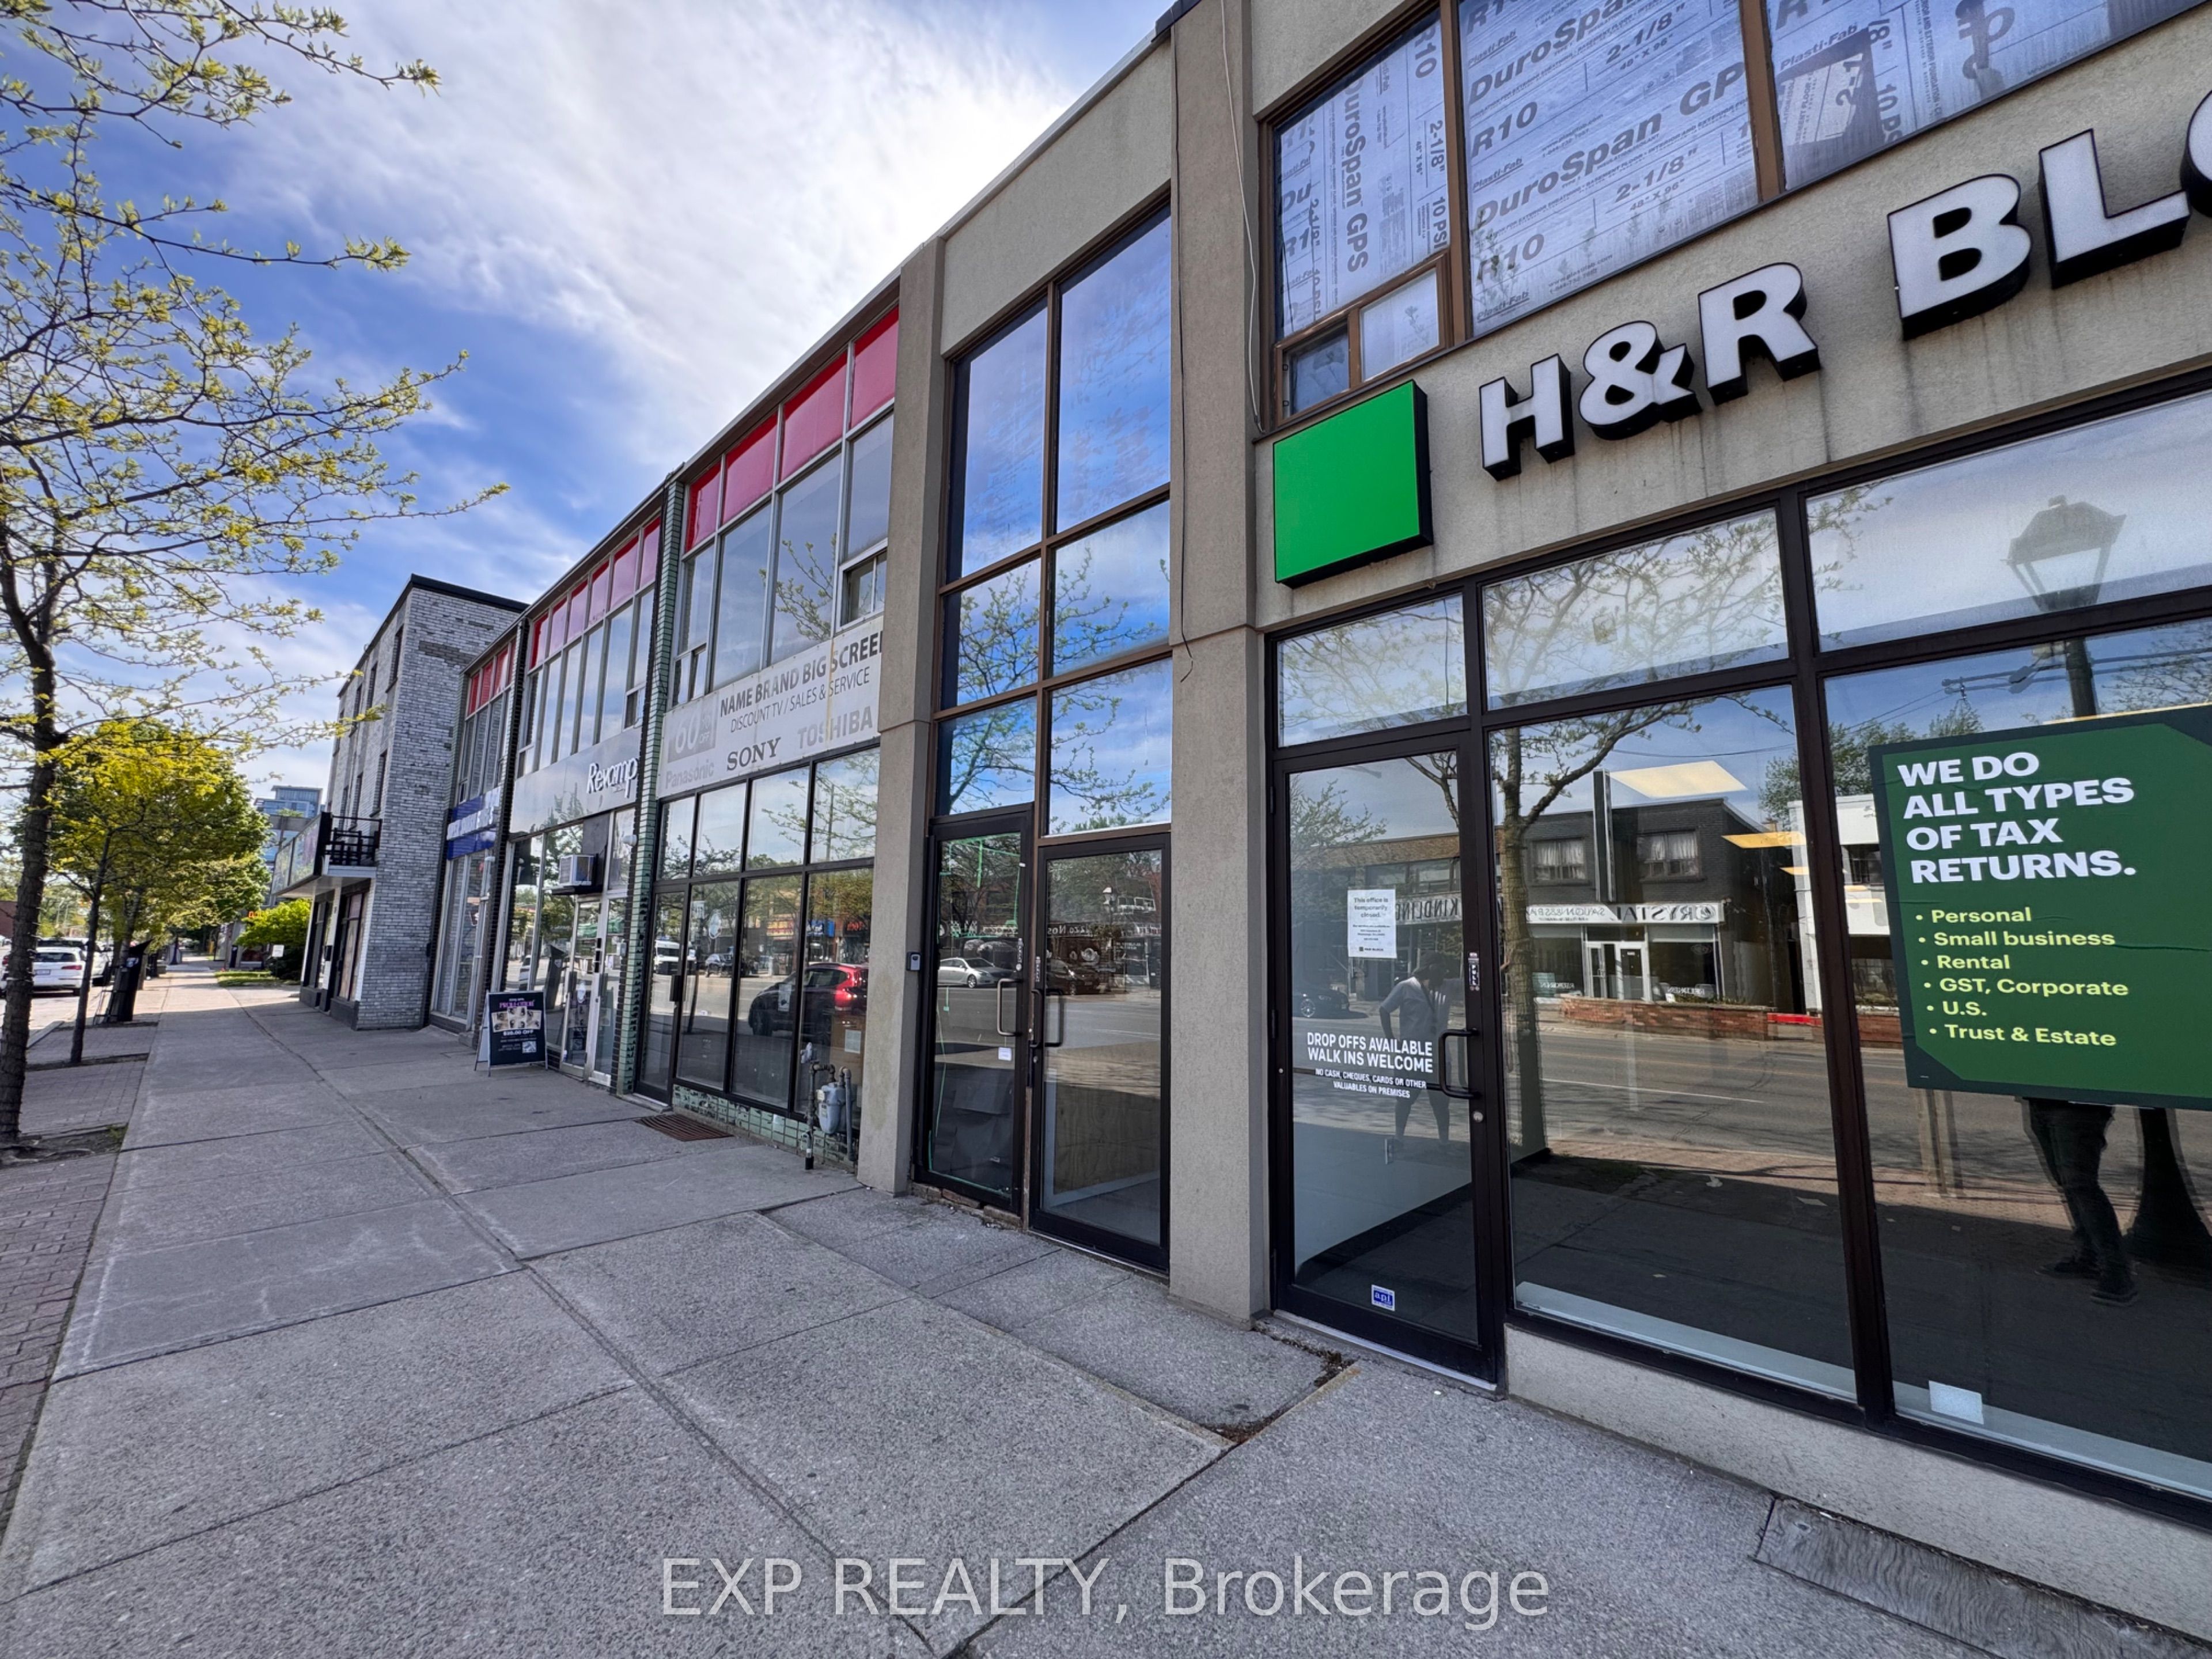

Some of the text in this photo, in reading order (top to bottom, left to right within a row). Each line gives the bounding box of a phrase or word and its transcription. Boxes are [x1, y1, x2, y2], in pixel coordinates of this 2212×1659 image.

[1471, 101, 1537, 158] R10
[1474, 113, 1662, 230] DuroSpan
[1615, 147, 1698, 202] 2-1/8"
[1432, 196, 1448, 249] 10 PSI
[1346, 213, 1369, 272] GPS
[1479, 262, 1820, 477] H&R
[721, 687, 753, 718] NAME
[755, 667, 799, 703] BRAND
[802, 655, 827, 684] BIG
[730, 705, 771, 733] DISCOUNT
[771, 698, 785, 718] TV
[790, 687, 817, 712] SALES
[819, 684, 826, 700] &
[829, 666, 870, 697] SERVICE
[665, 706, 873, 789] Panasonic SONY TOSHIBA
[586, 757, 638, 798] Revamp
[1897, 752, 2039, 787] WE DO
[1903, 777, 2134, 819] ALL TYPES
[1906, 817, 2063, 851] OF TAX
[1911, 850, 2136, 884] RETURNS.
[1931, 907, 2032, 923] Personal
[1934, 931, 2115, 946] Small business
[1937, 955, 2010, 969] Rental
[1940, 978, 2129, 997] GST, Corporate
[1943, 1001, 1987, 1016] U.S.
[1307, 1032, 1433, 1056] DROP OFFS AVAILABLE
[1945, 1024, 2116, 1046] Trust & Estate
[1307, 1047, 1433, 1073] WALK INS WELCOME
[1333, 1081, 1411, 1099] VALUABLES ON PREMISES
[1372, 1074, 1394, 1084] CARDS
[1395, 1077, 1405, 1086] OR
[1406, 1078, 1427, 1088] OTHER
